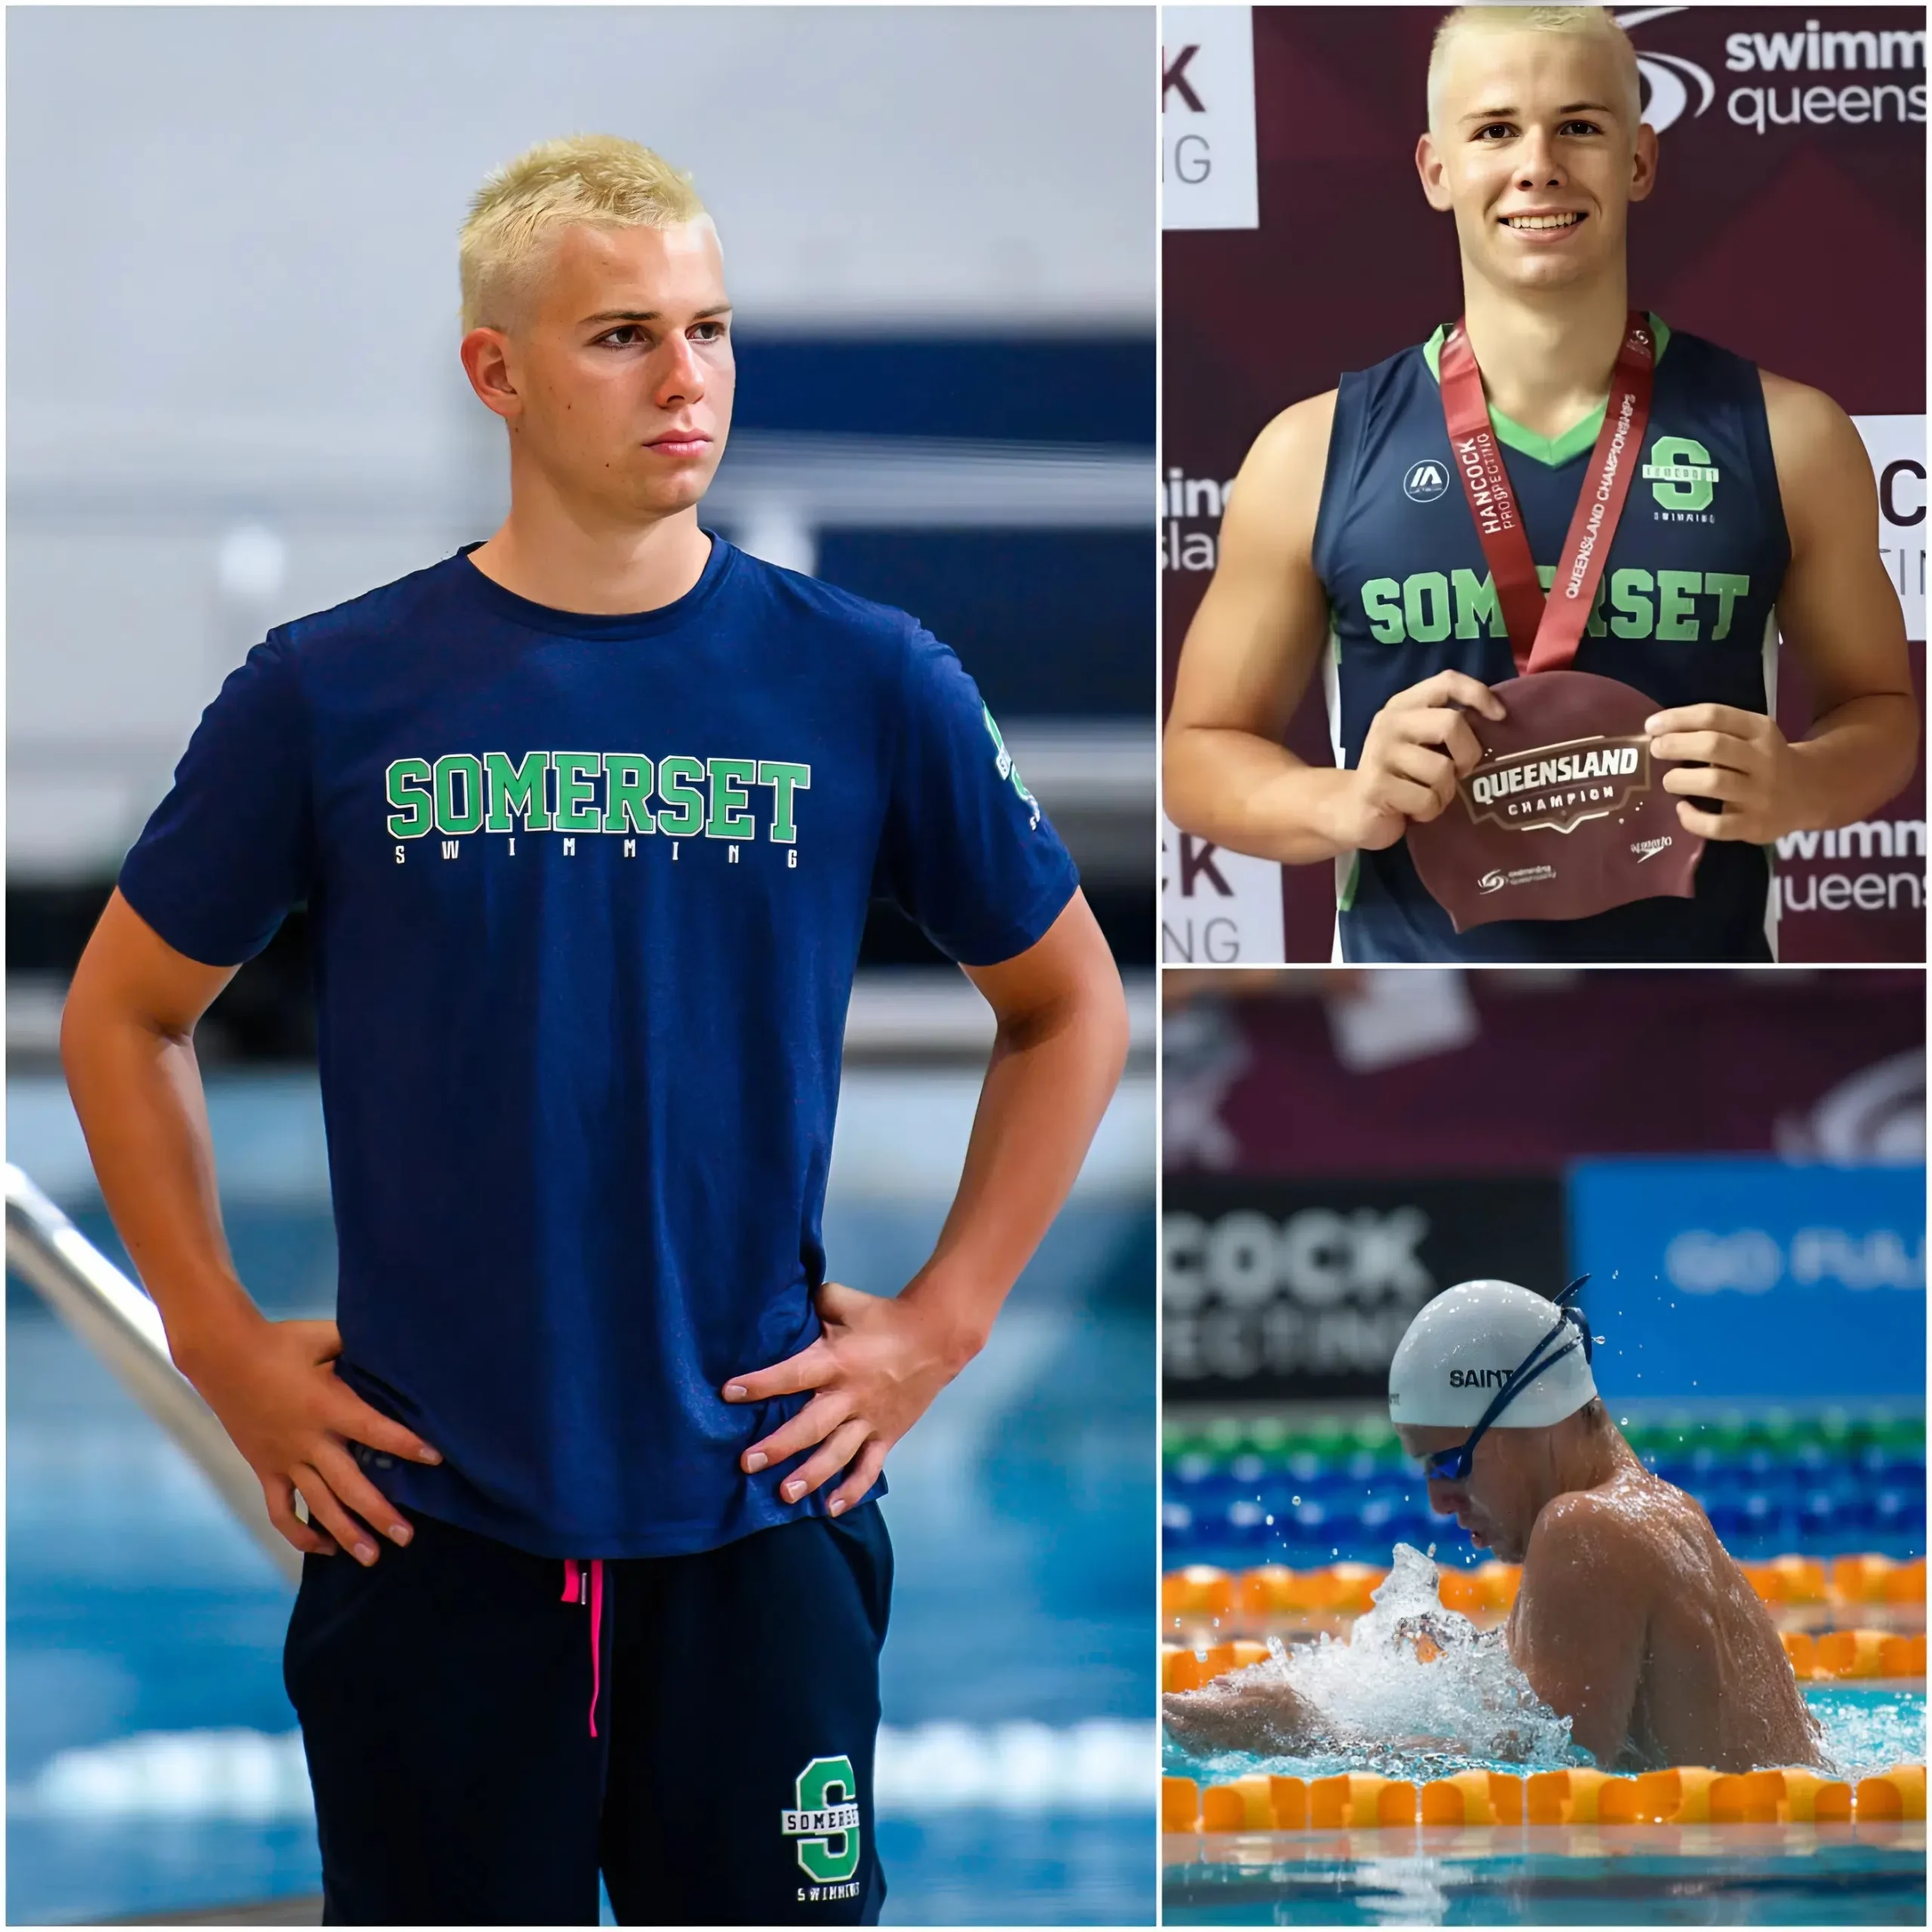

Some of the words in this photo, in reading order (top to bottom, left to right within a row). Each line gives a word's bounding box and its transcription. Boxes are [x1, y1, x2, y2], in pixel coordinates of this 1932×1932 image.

[1460, 437, 1502, 534] HANCOCK
[1565, 503, 1605, 599] QUEENSLAND
[386, 751, 811, 844] SOMERSET
[1472, 747, 1638, 805] QUEENSLAND
[1507, 786, 1614, 816] CHAMPION
[395, 837, 798, 868] SWIMMING
[1774, 872, 1926, 922] ueen
[1450, 1370, 1514, 1389] SAINT
